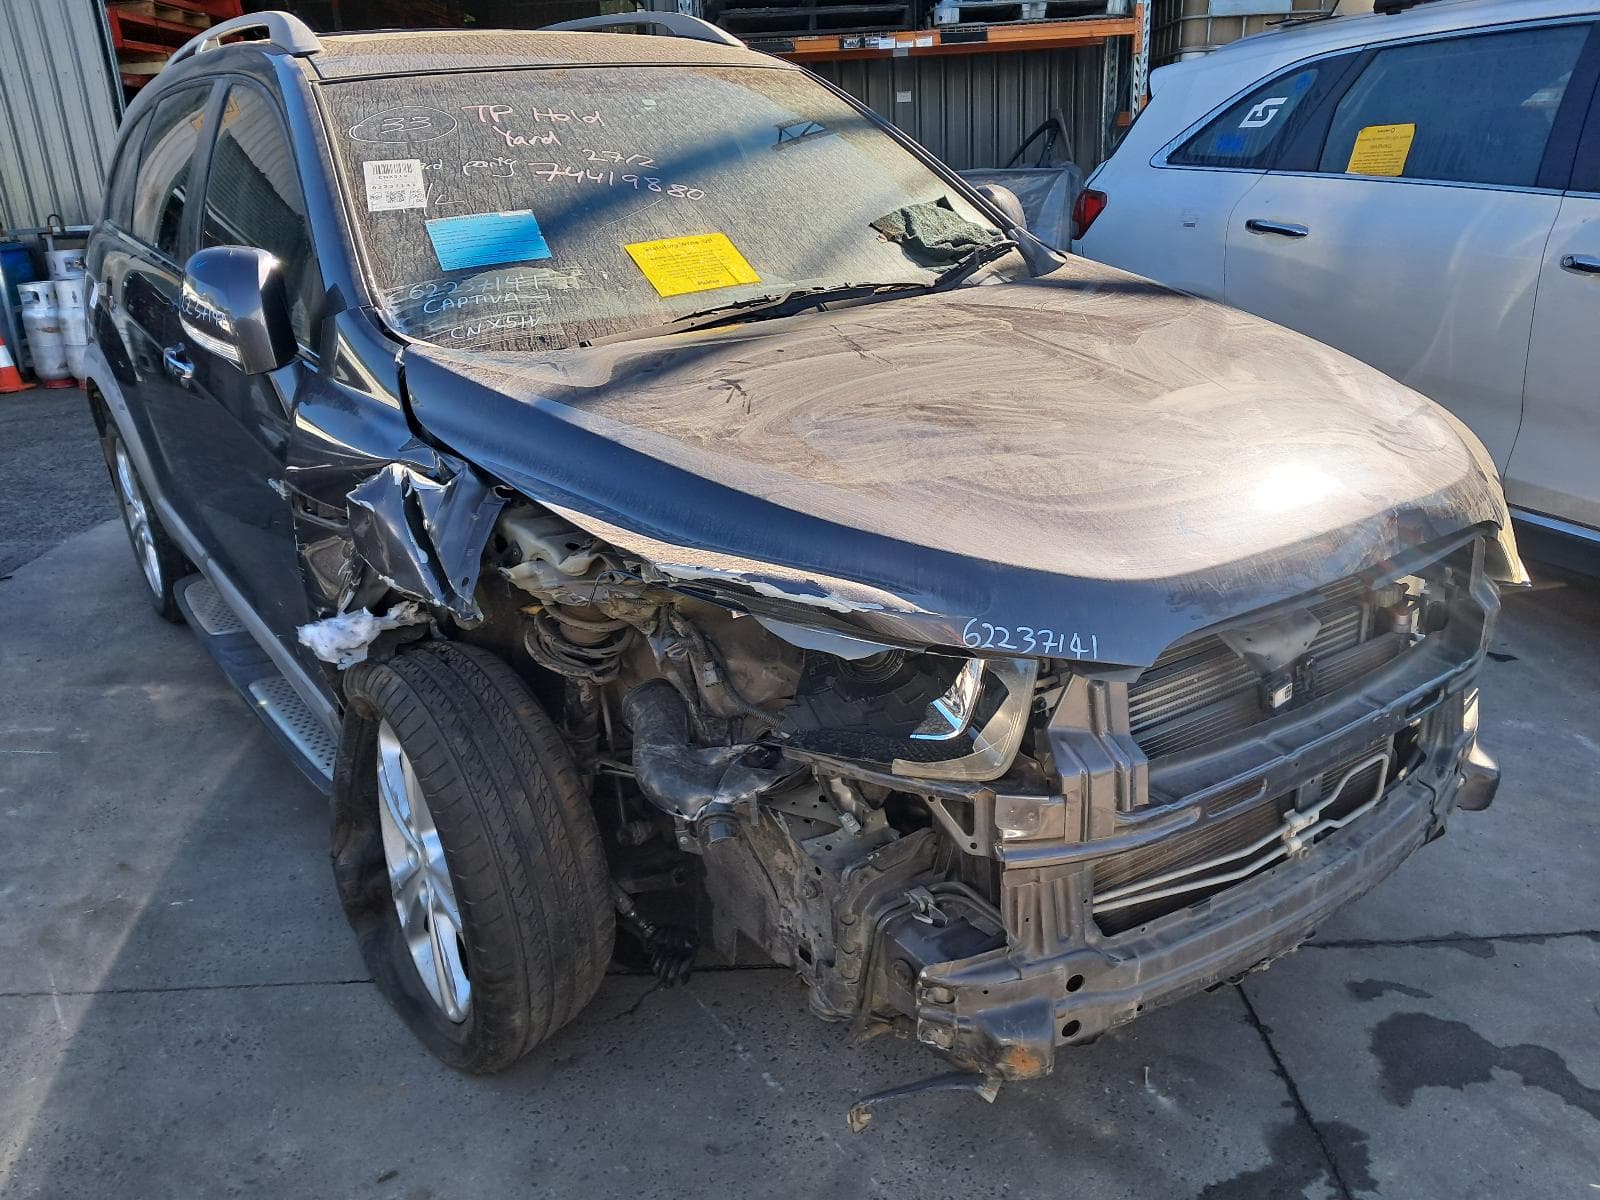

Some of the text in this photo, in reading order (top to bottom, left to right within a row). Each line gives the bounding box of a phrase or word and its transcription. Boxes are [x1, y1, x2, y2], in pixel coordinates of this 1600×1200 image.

[462, 104, 605, 126] TP Hold
[423, 292, 521, 314] CAPTIVA
[962, 617, 1098, 660] 62237141
